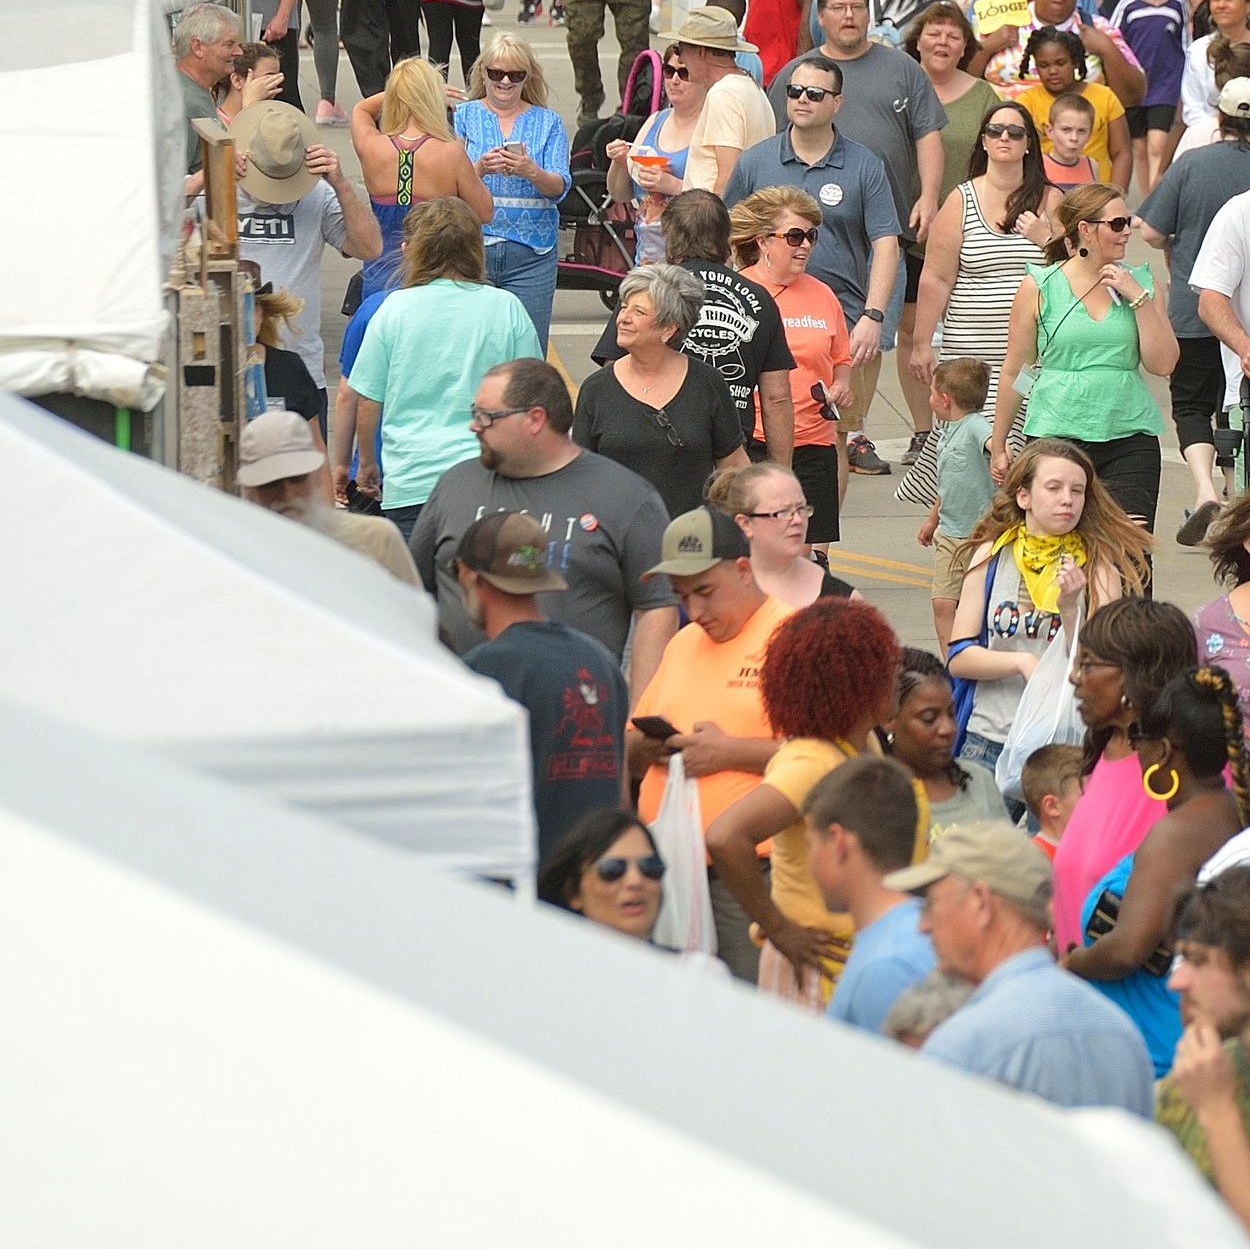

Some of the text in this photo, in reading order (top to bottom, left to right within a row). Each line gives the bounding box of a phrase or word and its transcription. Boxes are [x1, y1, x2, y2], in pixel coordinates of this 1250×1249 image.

[977, 1, 1027, 20] LODGE
[237, 217, 289, 235] YETI
[699, 270, 733, 286] YOUR
[734, 281, 763, 314] LOCAL
[688, 328, 736, 341] CYCLES
[729, 384, 751, 398] SHOP
